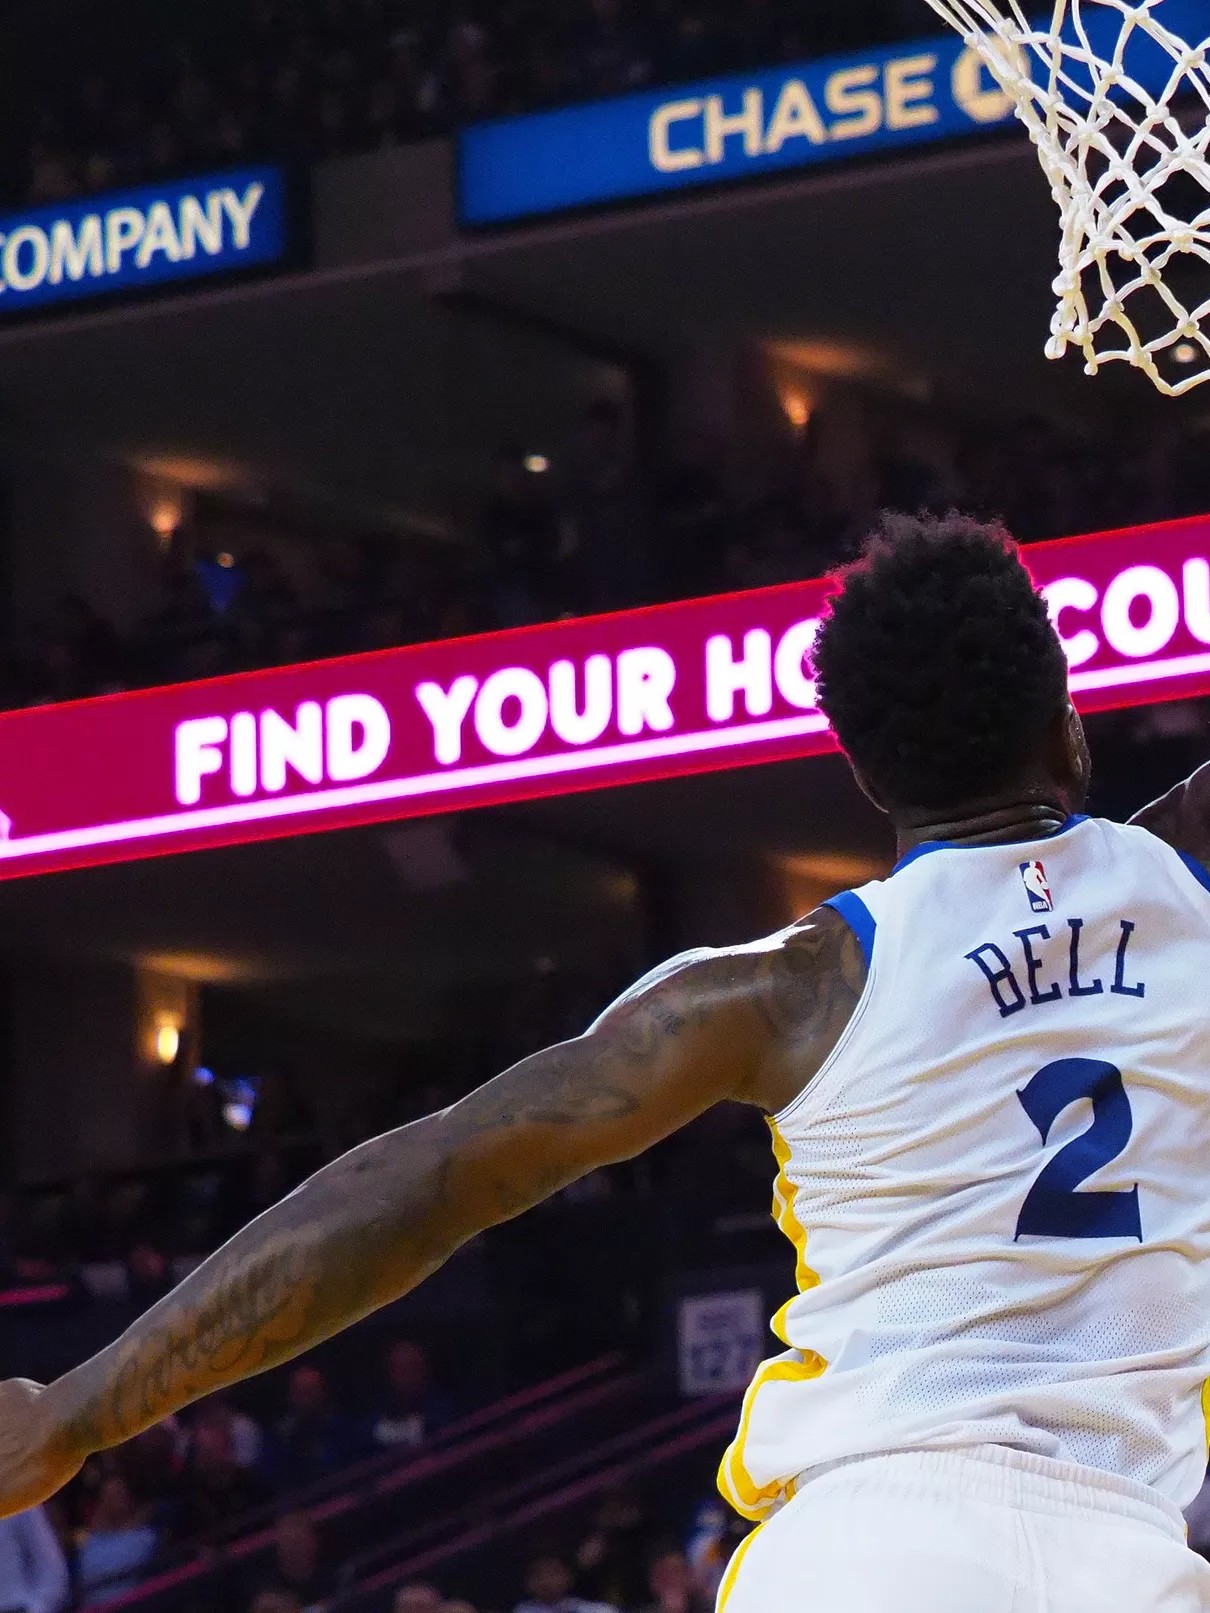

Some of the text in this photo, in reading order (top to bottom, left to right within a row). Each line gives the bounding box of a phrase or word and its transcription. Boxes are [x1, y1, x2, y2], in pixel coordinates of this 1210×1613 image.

[649, 53, 939, 172] CHASE
[0, 181, 265, 294] OMPANY
[174, 692, 392, 805] FIND
[414, 645, 677, 766] YOUR
[963, 918, 1145, 1018] BELL
[1013, 1057, 1144, 1243] 2
